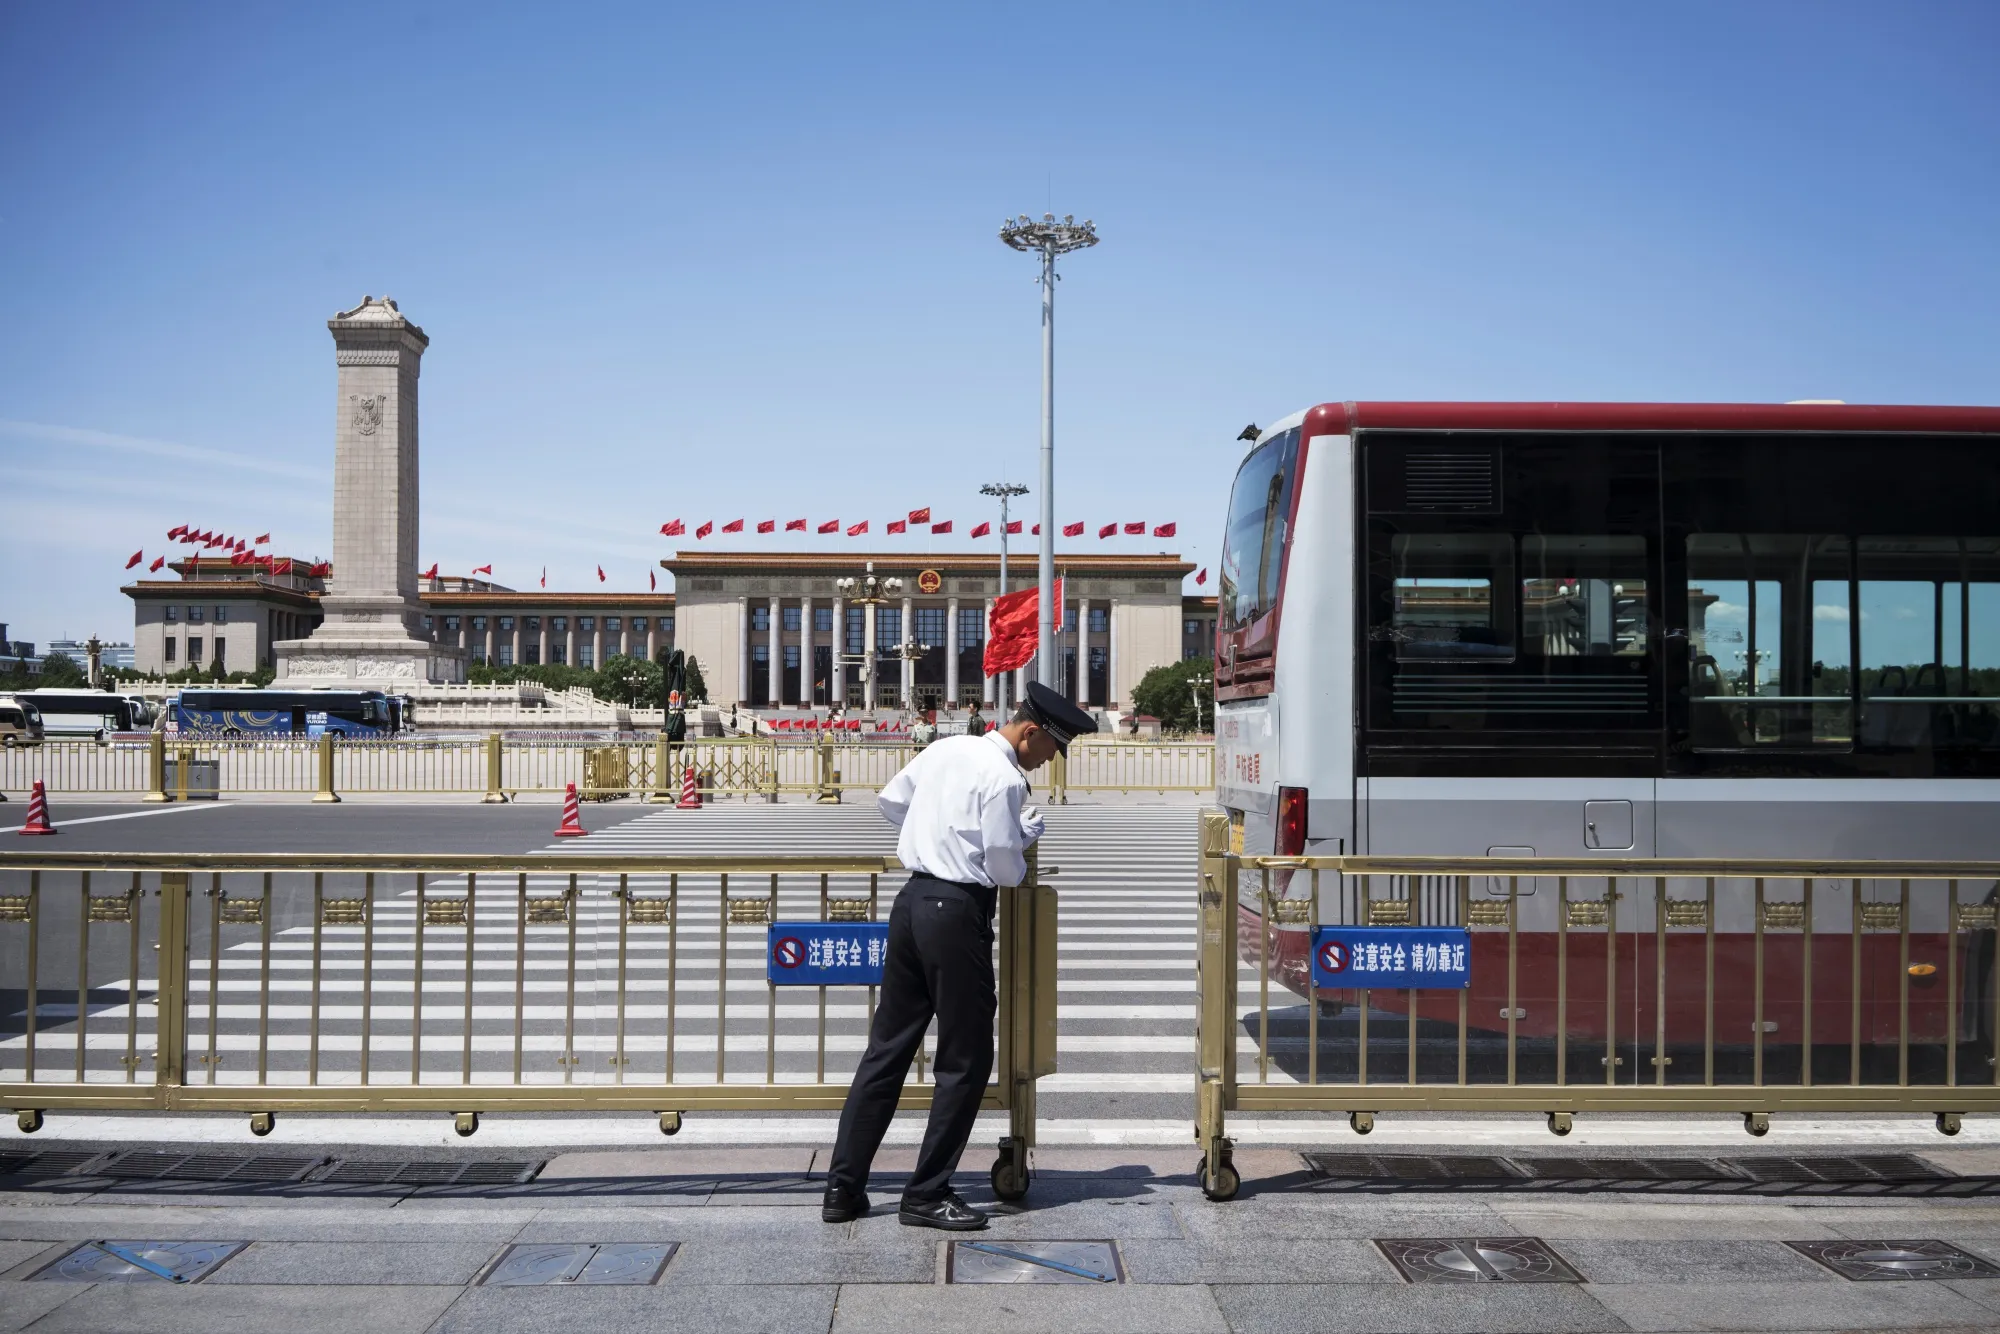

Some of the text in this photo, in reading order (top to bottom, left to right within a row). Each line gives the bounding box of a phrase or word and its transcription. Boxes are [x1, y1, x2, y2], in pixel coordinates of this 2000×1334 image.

[808, 938, 862, 967] 注意安全
[1352, 942, 1465, 973] 注意安全 请勿靠近
